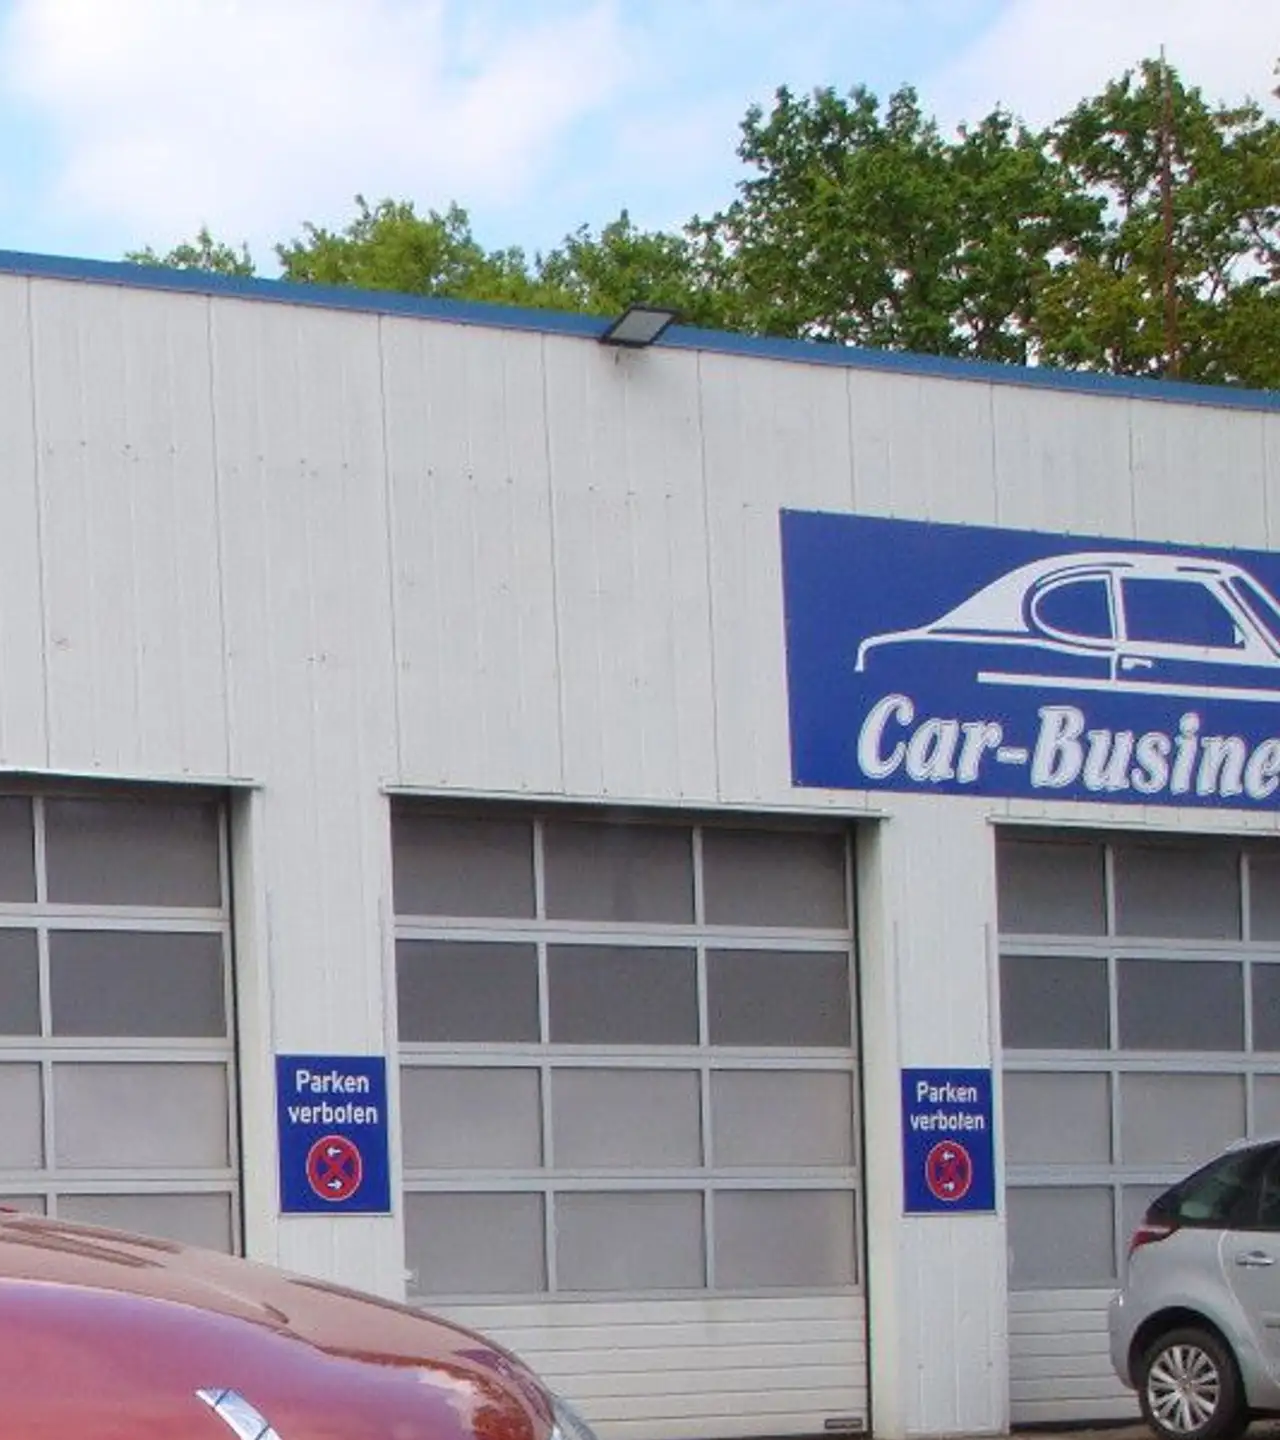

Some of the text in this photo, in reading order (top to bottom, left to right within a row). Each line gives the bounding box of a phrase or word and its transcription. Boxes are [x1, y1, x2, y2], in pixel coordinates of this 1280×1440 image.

[295, 1069, 370, 1093] Parken
[916, 1080, 978, 1103] Parken
[288, 1101, 378, 1124] verboten
[910, 1110, 985, 1131] verboten
